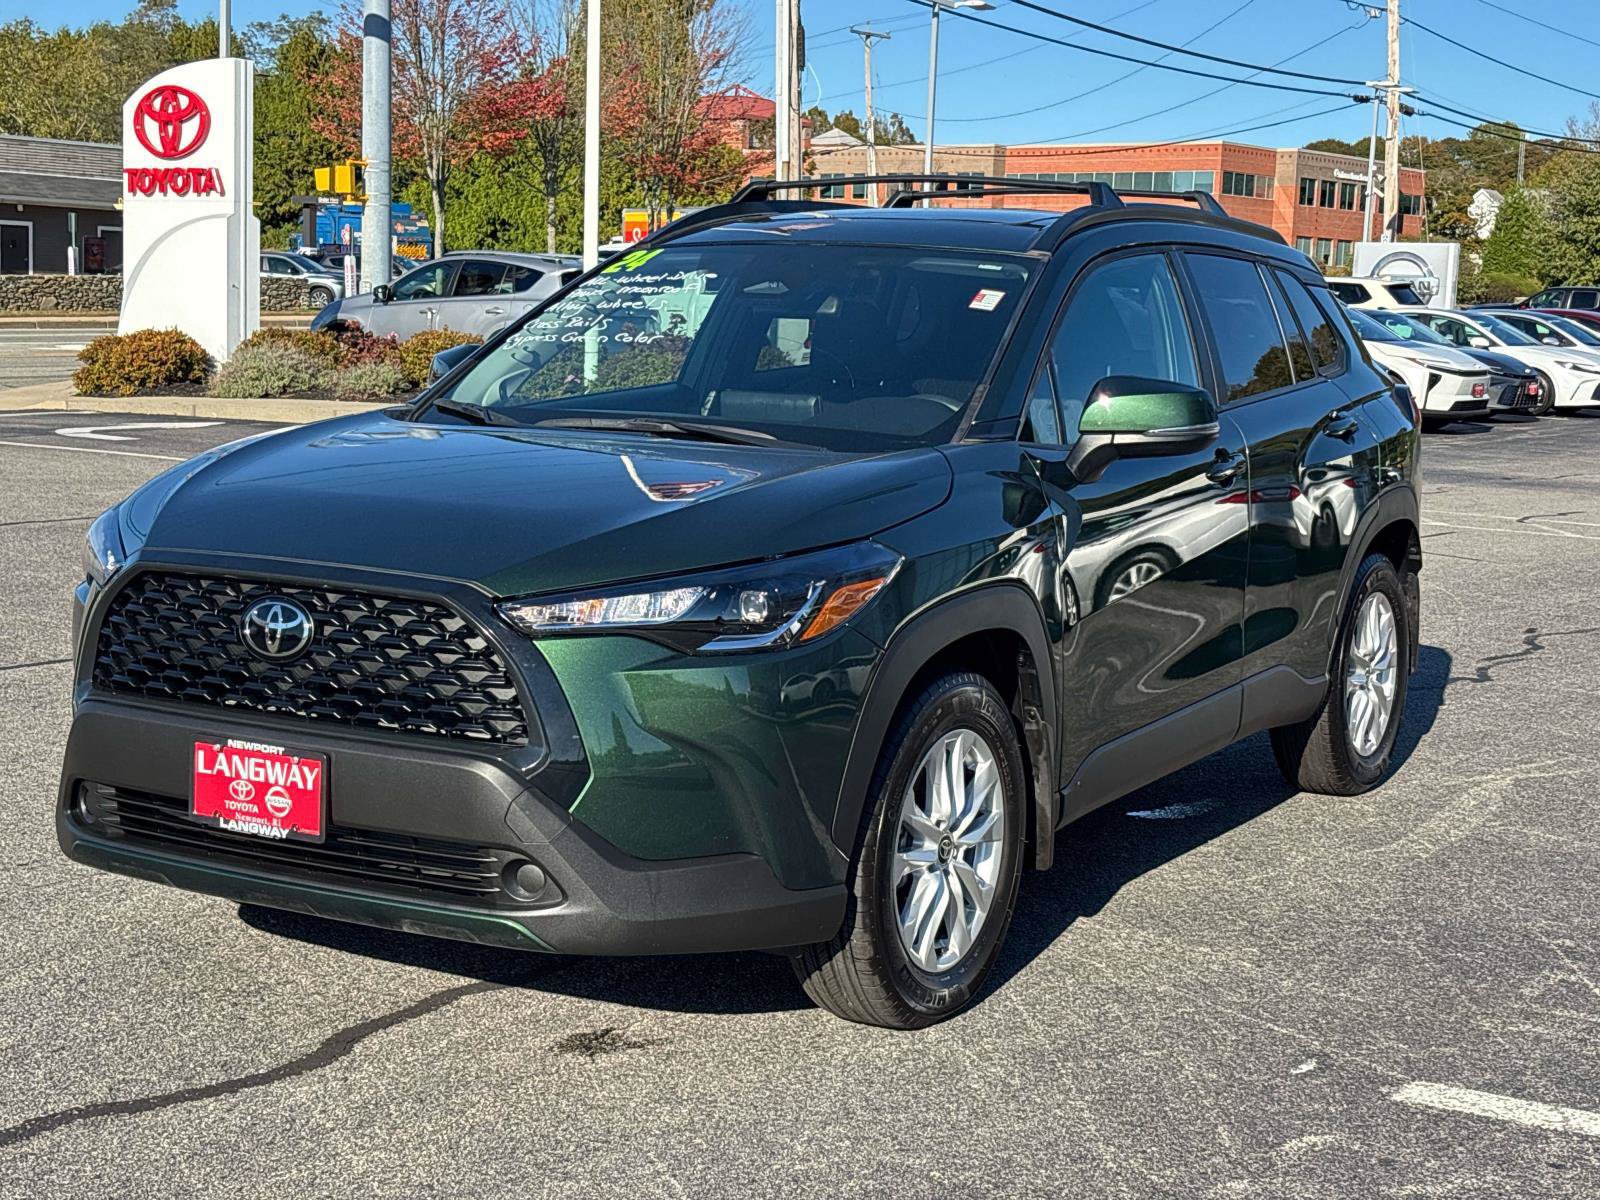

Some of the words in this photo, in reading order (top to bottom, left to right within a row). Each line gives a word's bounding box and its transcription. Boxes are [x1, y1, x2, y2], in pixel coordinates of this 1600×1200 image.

[123, 168, 225, 197] TOYOTA
[564, 314, 613, 331] Rails
[227, 739, 285, 756] NEWPORT
[197, 750, 320, 791] LANGWAY
[224, 800, 260, 814] TOYOTA
[219, 817, 291, 839] LANGWAY
